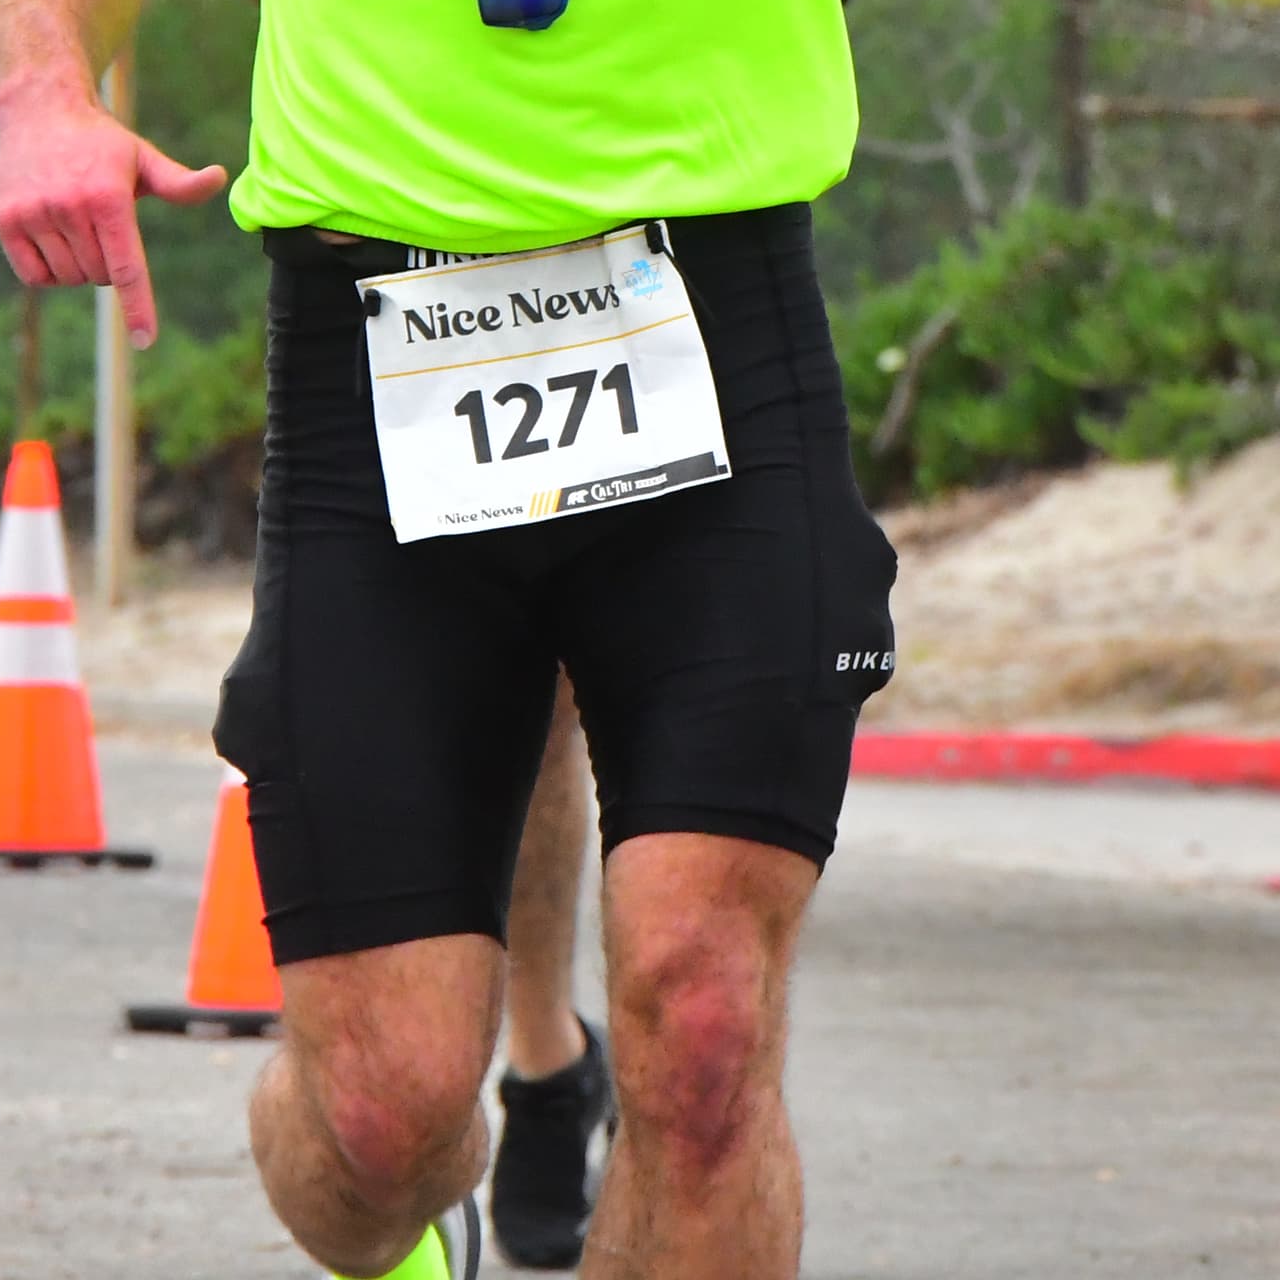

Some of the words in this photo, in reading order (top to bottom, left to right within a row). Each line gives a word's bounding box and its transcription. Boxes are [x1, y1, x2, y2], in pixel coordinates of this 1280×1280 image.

[402, 302, 503, 344] Nice
[508, 283, 620, 327] News
[454, 363, 639, 465] 1271
[444, 513, 478, 525] Nice
[481, 505, 524, 521] News
[836, 651, 895, 671] BIKE
